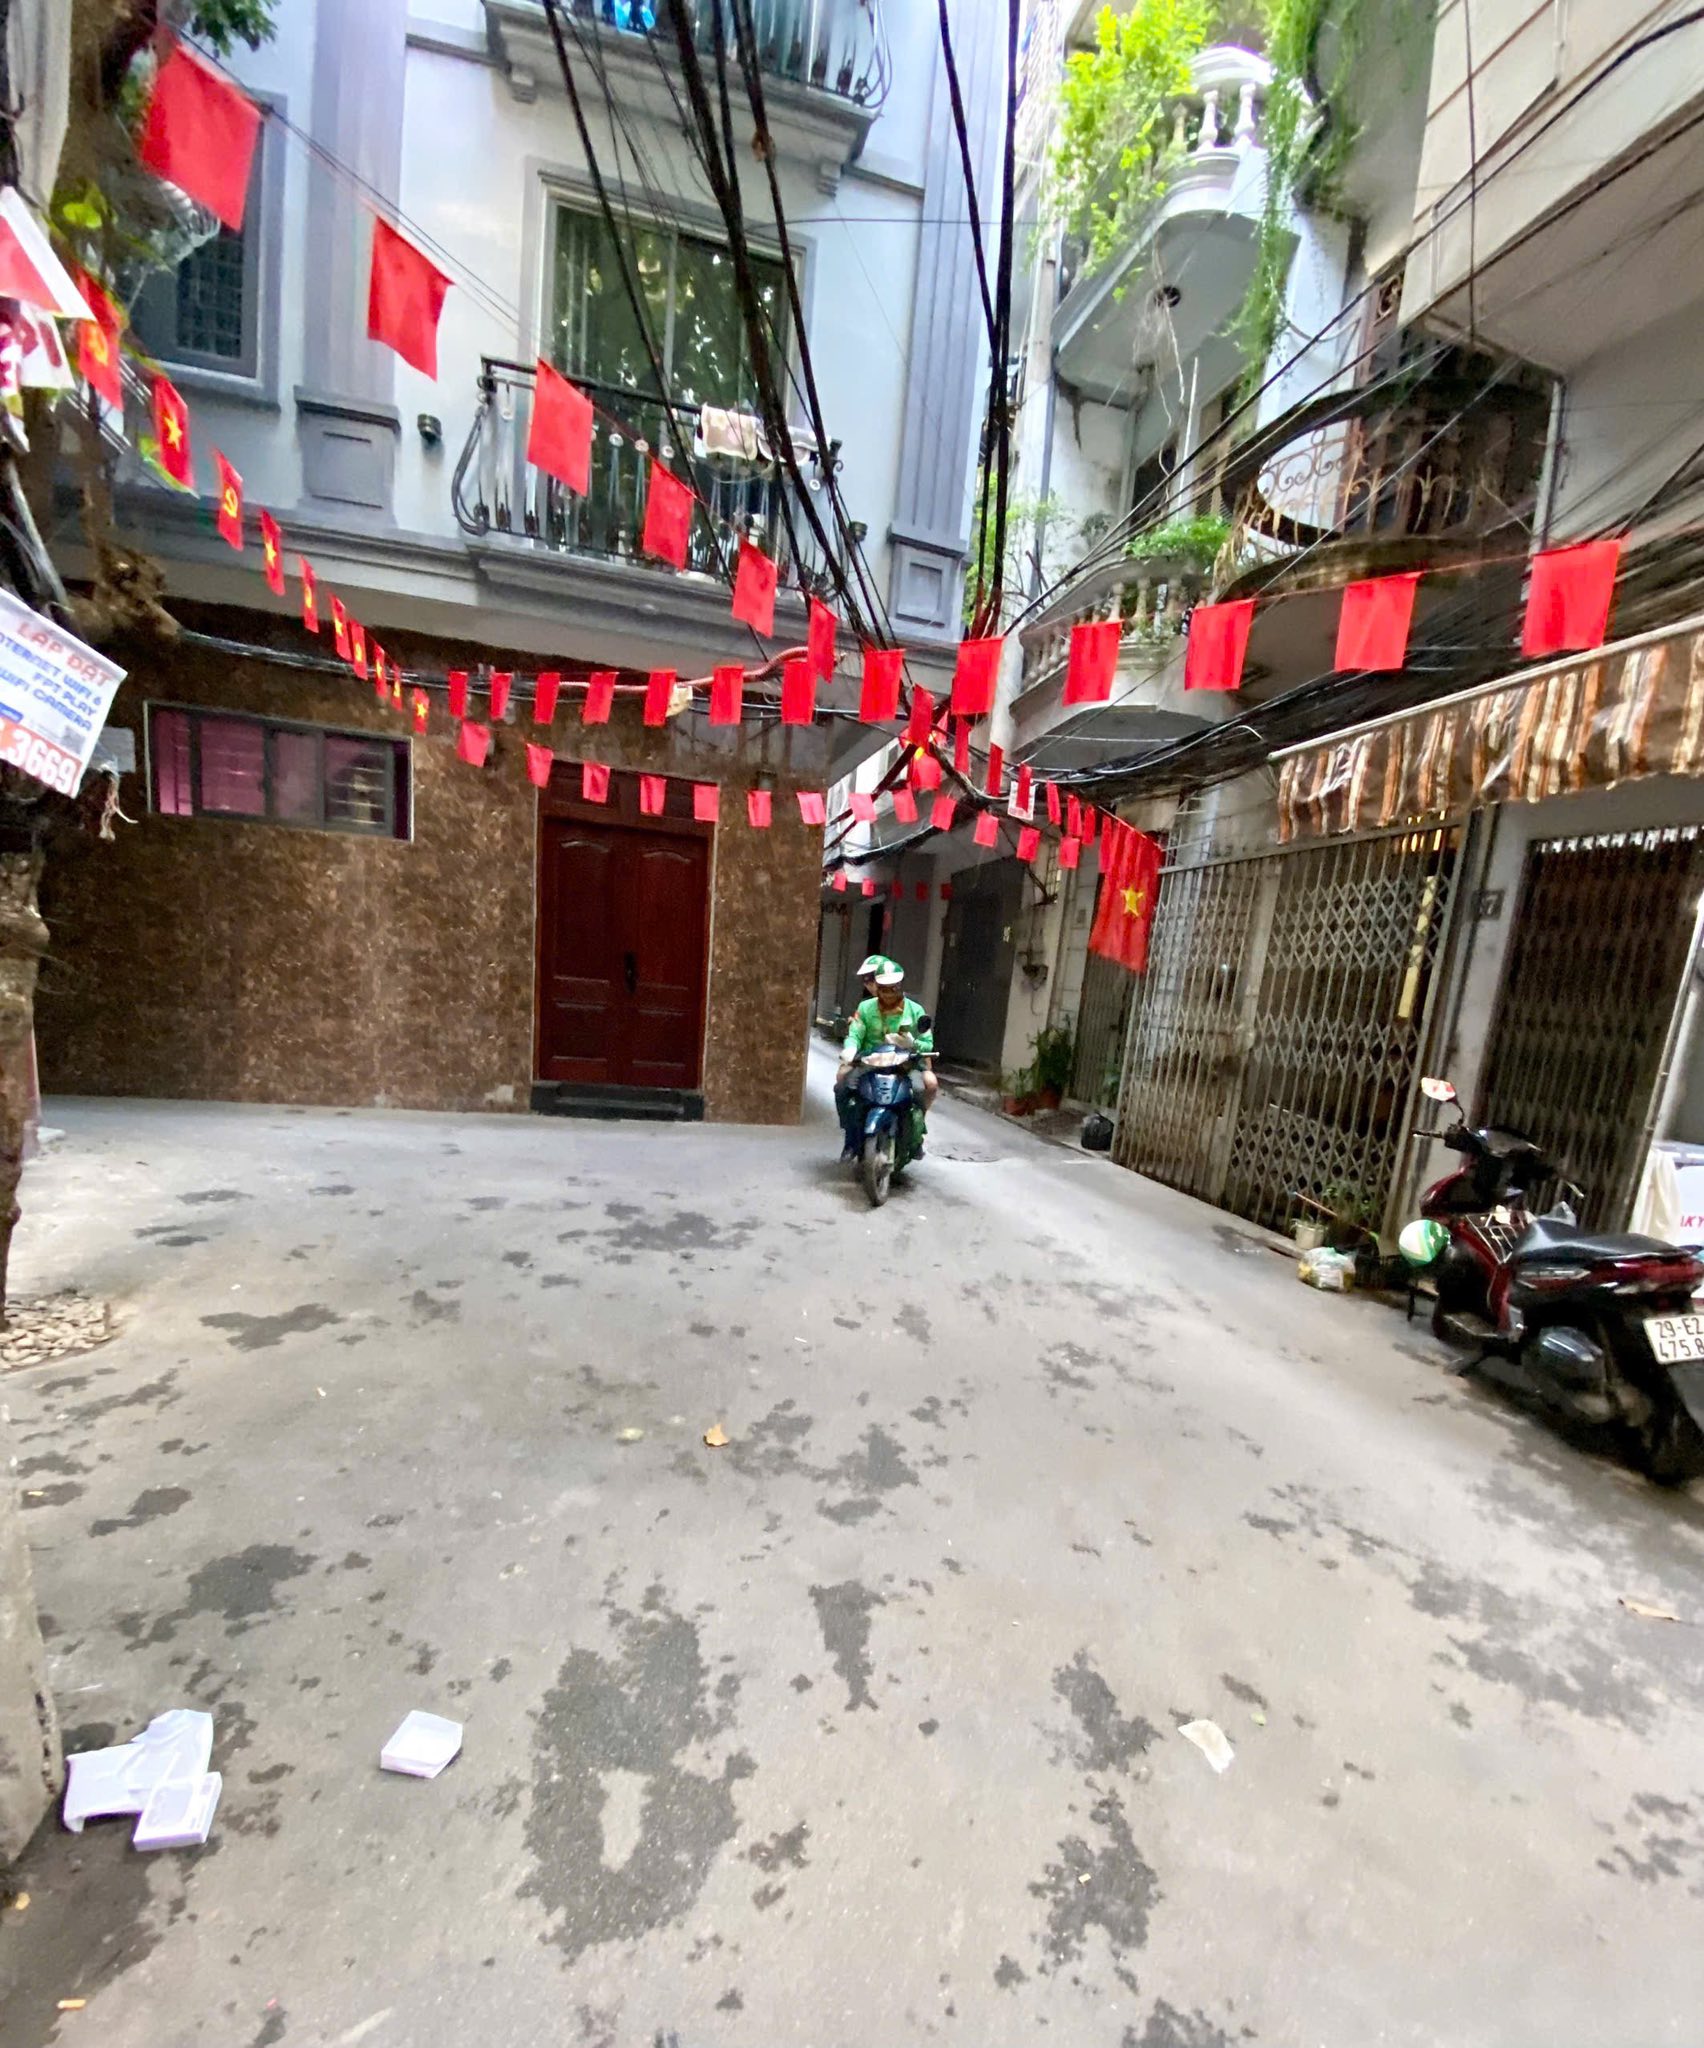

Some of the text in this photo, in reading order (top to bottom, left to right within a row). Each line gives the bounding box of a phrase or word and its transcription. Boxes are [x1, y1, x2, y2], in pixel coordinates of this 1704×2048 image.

[33, 672, 98, 717] FPT PLAY
[63, 674, 92, 699] WIFI
[93, 697, 102, 706] 6
[33, 688, 92, 732] CAMERA
[1655, 1317, 1704, 1338] 29-E2
